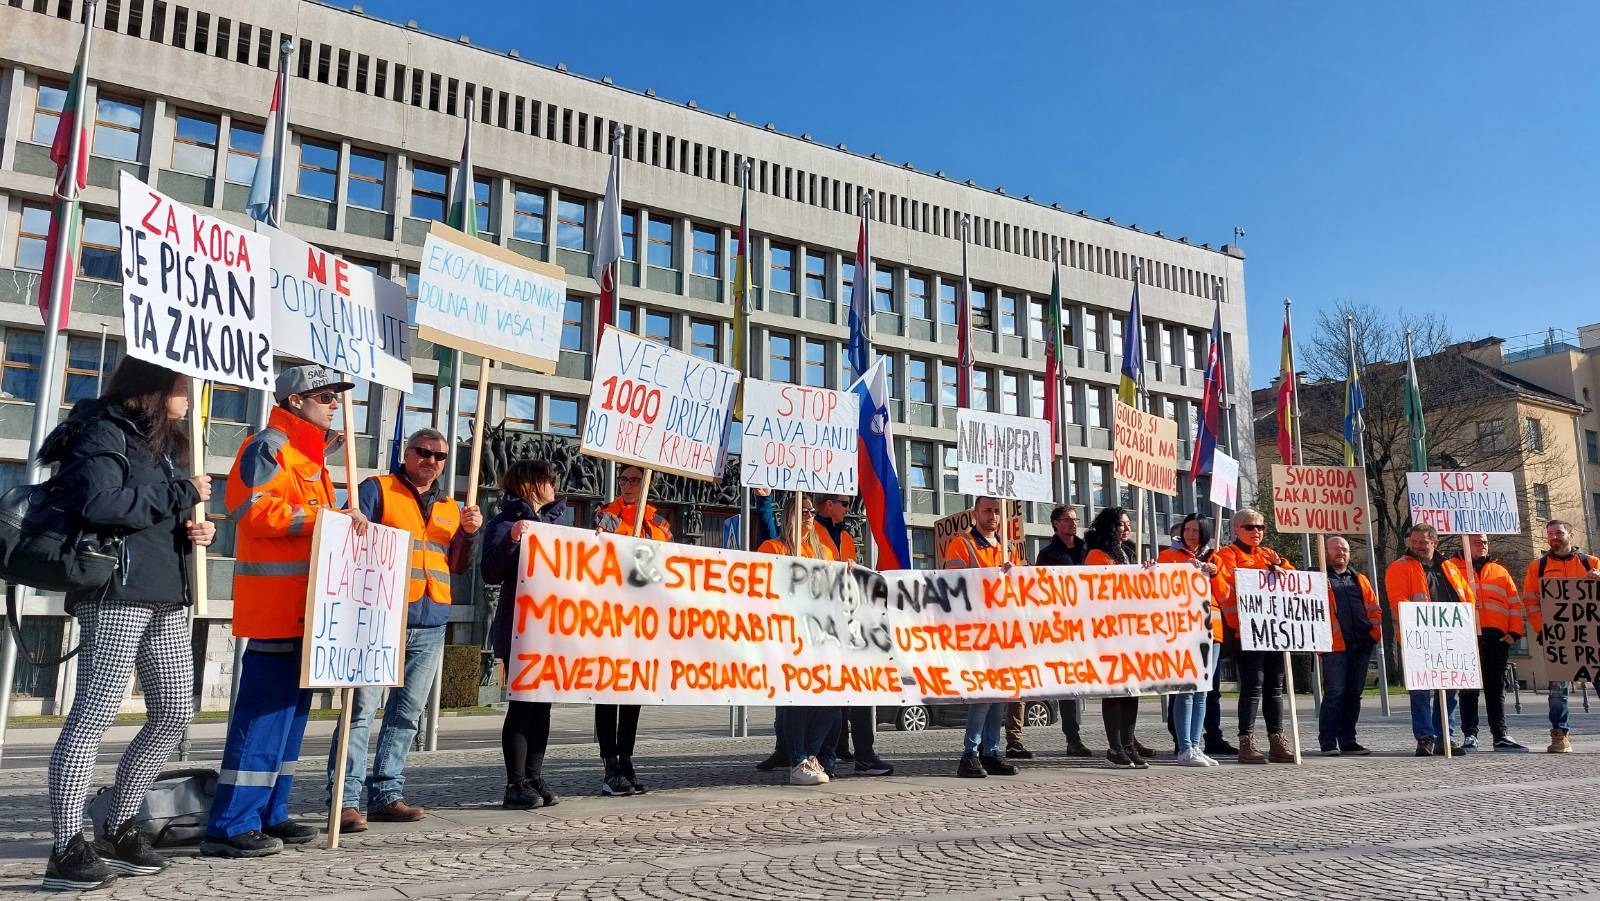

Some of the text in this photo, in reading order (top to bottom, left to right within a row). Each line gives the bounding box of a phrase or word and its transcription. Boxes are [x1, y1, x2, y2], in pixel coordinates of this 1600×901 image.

[141, 192, 252, 273] ZA KOGA
[125, 225, 256, 321] JE PISAN
[307, 247, 351, 297] NE
[130, 293, 270, 386] TA ZAKON?
[617, 333, 734, 405] VEČ KOT
[601, 375, 730, 448] 1000 DRUŽIN
[777, 387, 838, 424] STOP
[586, 409, 609, 448] BO
[615, 419, 654, 459] BREZ
[744, 414, 859, 454] ZAVAJANJU
[1115, 423, 1176, 460] POZABIL NA
[1148, 417, 1158, 435] SI
[765, 441, 833, 473] ODSTOP
[1114, 449, 1144, 482] SVOJO
[986, 468, 1017, 497] EUR
[1286, 466, 1358, 489] SVOBODA
[1440, 472, 1474, 491] KDO
[1274, 487, 1354, 505] ZAKAJ SMO
[1410, 492, 1510, 511] BO NASLEDNJA
[937, 511, 974, 538] DOVOL
[1275, 507, 1300, 527] VAS
[1305, 508, 1349, 532] VOLILI
[342, 520, 397, 571] NAROD
[326, 552, 396, 610] LAČEN
[526, 534, 622, 586] NIKA
[664, 556, 780, 600] STEGEL
[896, 576, 973, 613] NAM
[982, 567, 1078, 610] KAKŠNO
[1079, 570, 1209, 608] TEHNOLOGIJO
[1258, 570, 1312, 595] DOVOLJ
[1541, 579, 1570, 600] KJE
[515, 593, 660, 641] MORAMO
[895, 622, 1026, 653] USTREZALA
[1032, 610, 1085, 645] VAŠIM
[1239, 594, 1263, 615] NAM
[1282, 592, 1325, 622] LAŽNIH
[1416, 605, 1463, 628] NIKA
[315, 602, 392, 649] JE FUL
[1405, 629, 1454, 651] KDO TE
[1543, 624, 1588, 643] KO JE
[314, 645, 397, 683] DRUGAČEN
[1546, 641, 1600, 665] ŠE PR
[510, 653, 660, 692] ZAVEDENI
[960, 664, 1042, 699] SPREJETI
[1045, 655, 1101, 686] TEGA
